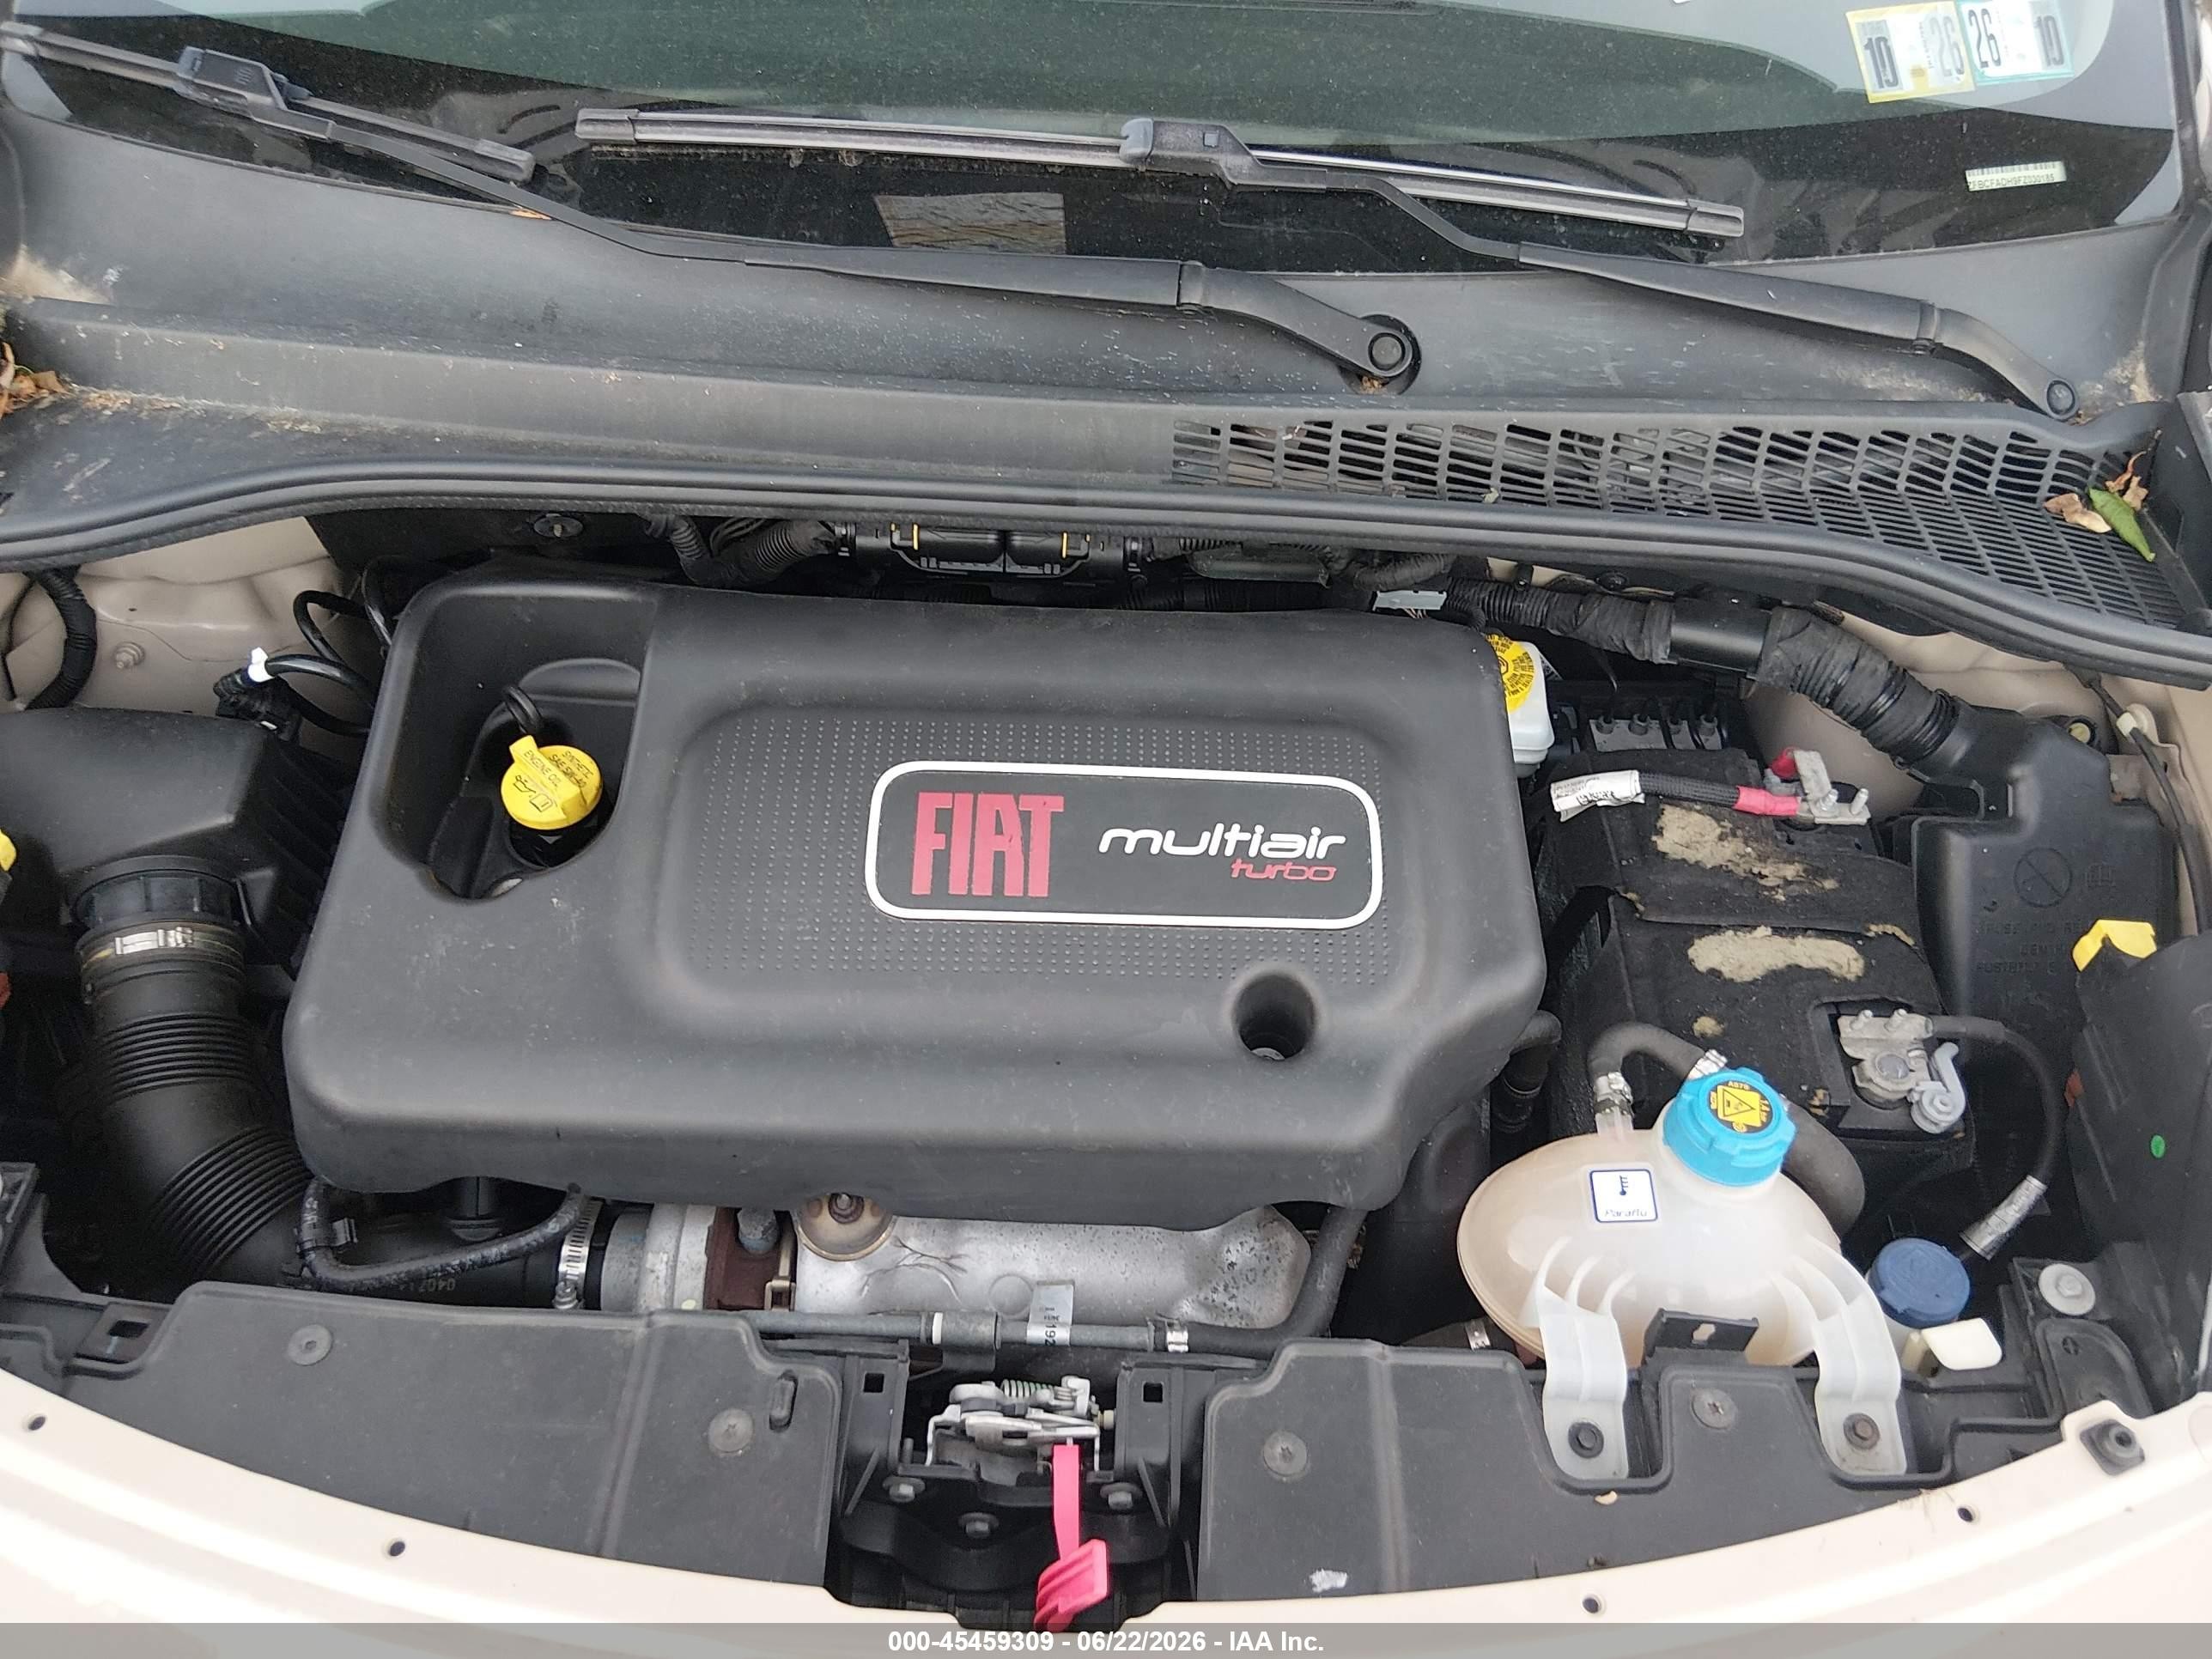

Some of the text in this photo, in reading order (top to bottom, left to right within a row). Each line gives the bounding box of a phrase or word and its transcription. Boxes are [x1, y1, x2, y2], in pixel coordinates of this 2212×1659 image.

[1863, 36, 1899, 89] 10
[1967, 8, 2002, 69] 26
[2034, 15, 2065, 67] 10
[911, 792, 1065, 897] FIAT
[1098, 823, 1347, 860] multiair
[1231, 859, 1338, 882] turbo
